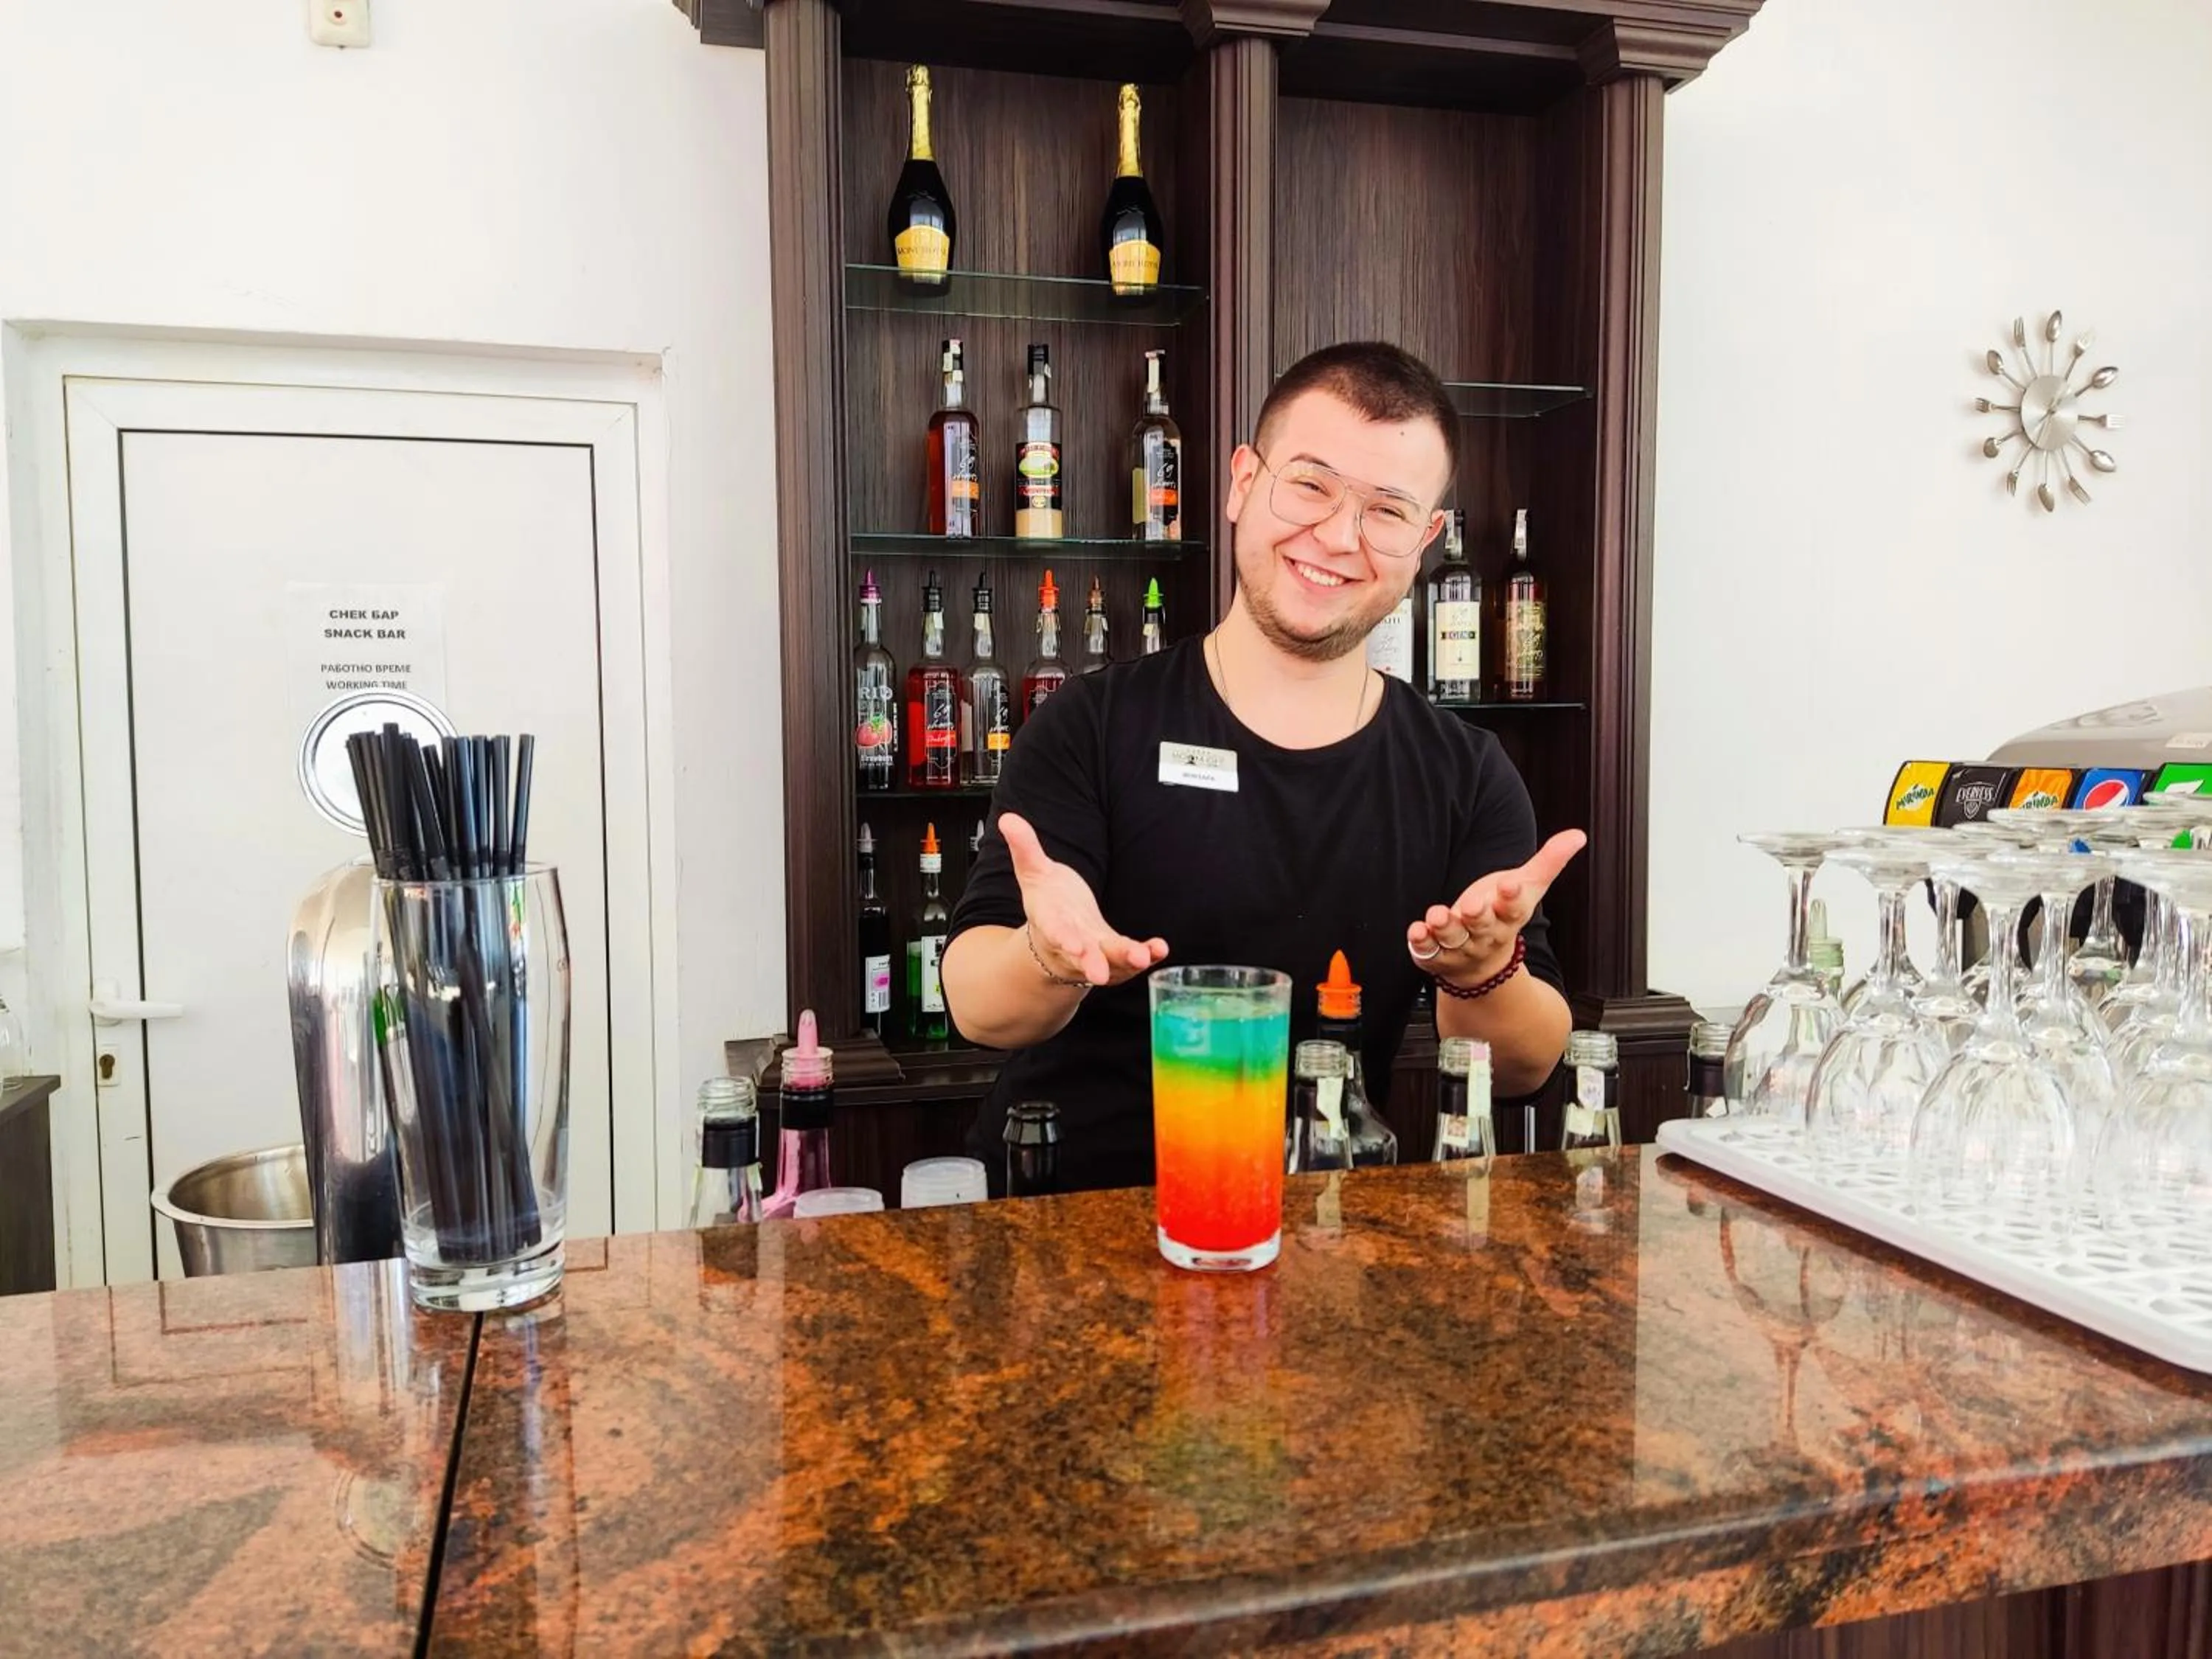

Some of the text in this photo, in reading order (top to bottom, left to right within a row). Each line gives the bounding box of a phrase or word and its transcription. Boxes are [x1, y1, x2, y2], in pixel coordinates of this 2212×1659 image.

[329, 610, 400, 620] СНЕК БАР
[324, 629, 406, 639] SNACK BAR
[321, 664, 411, 673] РАБОТНО ВРЕМЕ
[326, 680, 408, 690] WORKING TIME
